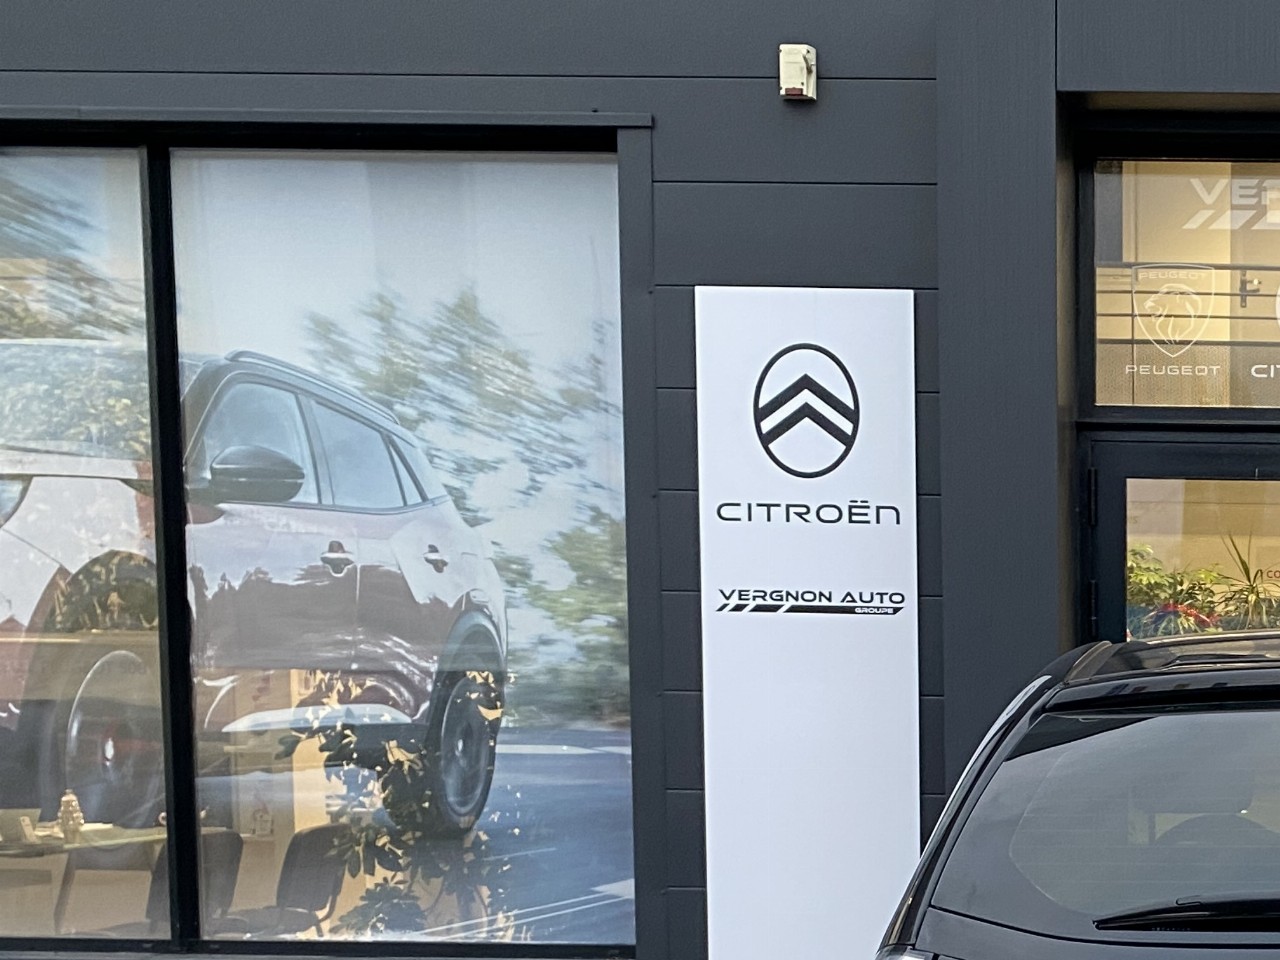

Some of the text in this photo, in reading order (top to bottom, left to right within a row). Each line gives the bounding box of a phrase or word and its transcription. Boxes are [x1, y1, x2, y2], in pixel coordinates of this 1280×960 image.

[1125, 364, 1221, 377] PEUGEOT
[717, 500, 901, 525] CITROËN
[719, 589, 905, 604] VERGNON AUTO
